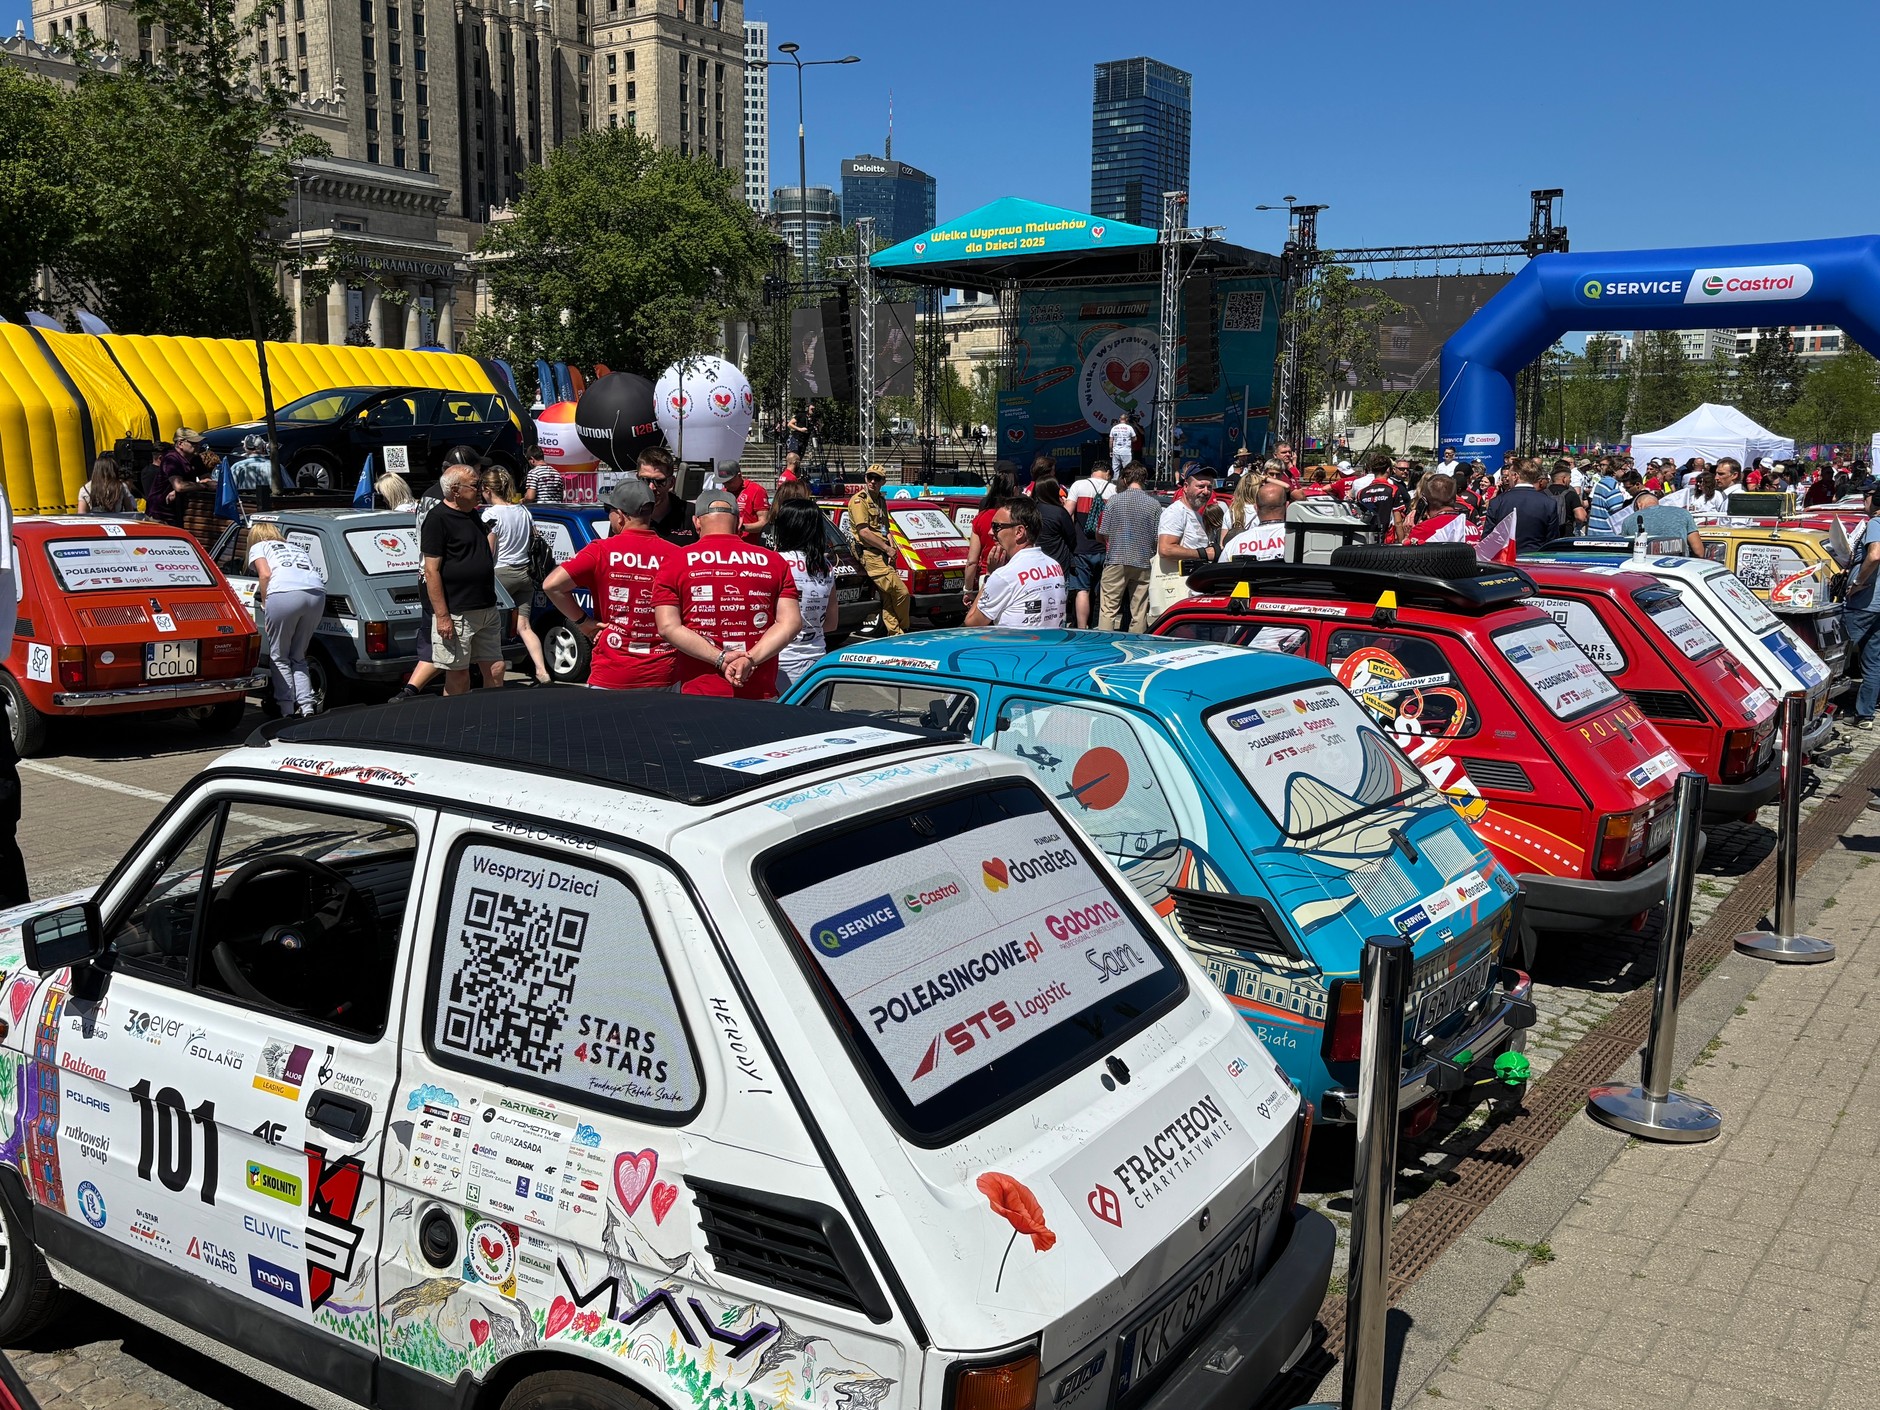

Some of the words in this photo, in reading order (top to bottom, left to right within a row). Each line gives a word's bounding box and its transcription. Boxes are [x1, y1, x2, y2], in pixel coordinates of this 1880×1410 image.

[931, 228, 967, 243] Wielka
[970, 224, 1022, 241] Wyprawa
[1026, 218, 1087, 232] Maluchów
[965, 242, 982, 253] dla
[985, 239, 1017, 252] Dzieci
[1020, 237, 1045, 248] 2025
[1606, 281, 1682, 295] SERVICE
[1726, 275, 1794, 293] Castrol
[1096, 336, 1148, 358] Wyprawa
[1085, 361, 1098, 406] Wielka
[63, 550, 88, 558] SERVICE
[148, 548, 190, 557] donateo
[609, 552, 664, 570] POLA
[687, 551, 768, 566] POLAND
[65, 565, 149, 576] POLEASINGOWE.pl
[155, 563, 200, 572] Gabona
[90, 577, 123, 585] STS
[169, 573, 201, 582] Sam
[1372, 664, 1396, 678] RYGA
[1428, 675, 1445, 684] 2025
[1236, 713, 1261, 725] SERVICE
[1306, 697, 1341, 712] donateo
[1366, 695, 1394, 715] HELSINKI
[1248, 728, 1305, 751] POLEASINGOWE.pl
[1303, 717, 1335, 732] Gabona
[1273, 746, 1298, 761] STS
[1297, 742, 1318, 755] Logistic
[1322, 733, 1346, 747] Sam
[282, 757, 328, 771] NICEONE
[472, 855, 546, 889] Wesprzyj
[547, 871, 600, 898] Dzieci
[837, 907, 896, 940] SERVICE
[918, 881, 961, 907] Castrol
[1008, 846, 1078, 884] donateo
[1404, 910, 1427, 928] SERVICE
[1465, 880, 1488, 898] donateo
[869, 932, 1044, 1034] POLEASINGOWE.pl
[1045, 901, 1120, 941] Gabona
[944, 999, 1017, 1056] STS
[1014, 980, 1072, 1020] Logistic
[1085, 943, 1145, 984] Sam
[579, 1014, 656, 1053] STARS
[1257, 1026, 1297, 1049] Biała
[190, 1045, 243, 1070] SOLANO
[226, 1049, 245, 1058] GROUP
[574, 1042, 668, 1083] 4STARS
[61, 1052, 107, 1081] Baltona
[285, 1070, 303, 1081] ALIOR
[1227, 1056, 1249, 1078] G2A
[262, 1081, 285, 1094] LEASING
[333, 1080, 379, 1101] CONNECTIONS
[335, 1072, 365, 1087] CHARITY
[589, 1077, 624, 1097] Fundacja
[621, 1082, 654, 1098] Rafała
[653, 1087, 684, 1102] Sonika
[66, 1089, 111, 1113] POLARIS
[500, 1098, 558, 1121] PARTNERZY
[1265, 1091, 1279, 1106] CHARITY
[64, 1125, 110, 1151] rutkowski
[496, 1115, 562, 1139] AUTOMOTIVE
[128, 1078, 219, 1206] 101
[479, 1145, 498, 1157] alpha
[490, 1131, 542, 1154] GRUPAZASADA
[1113, 1094, 1223, 1195] FRACTHON
[80, 1144, 108, 1165] group
[505, 1156, 535, 1171] EKOPARK
[1134, 1119, 1233, 1209] CHARYTATYWNIE
[262, 1173, 297, 1196] SKOLNITY
[536, 1181, 556, 1196] HSK
[474, 1223, 502, 1234] Wyprawa
[202, 1240, 236, 1263] ATLAS
[502, 1232, 512, 1273] Maluchów
[203, 1252, 238, 1275] WARD
[464, 1262, 478, 1281] 2025
[475, 1264, 484, 1275] dla
[486, 1272, 503, 1281] Dzieci
[257, 1269, 294, 1292] moya
[501, 1278, 516, 1293] 2025
[1136, 1299, 1178, 1380] KK
